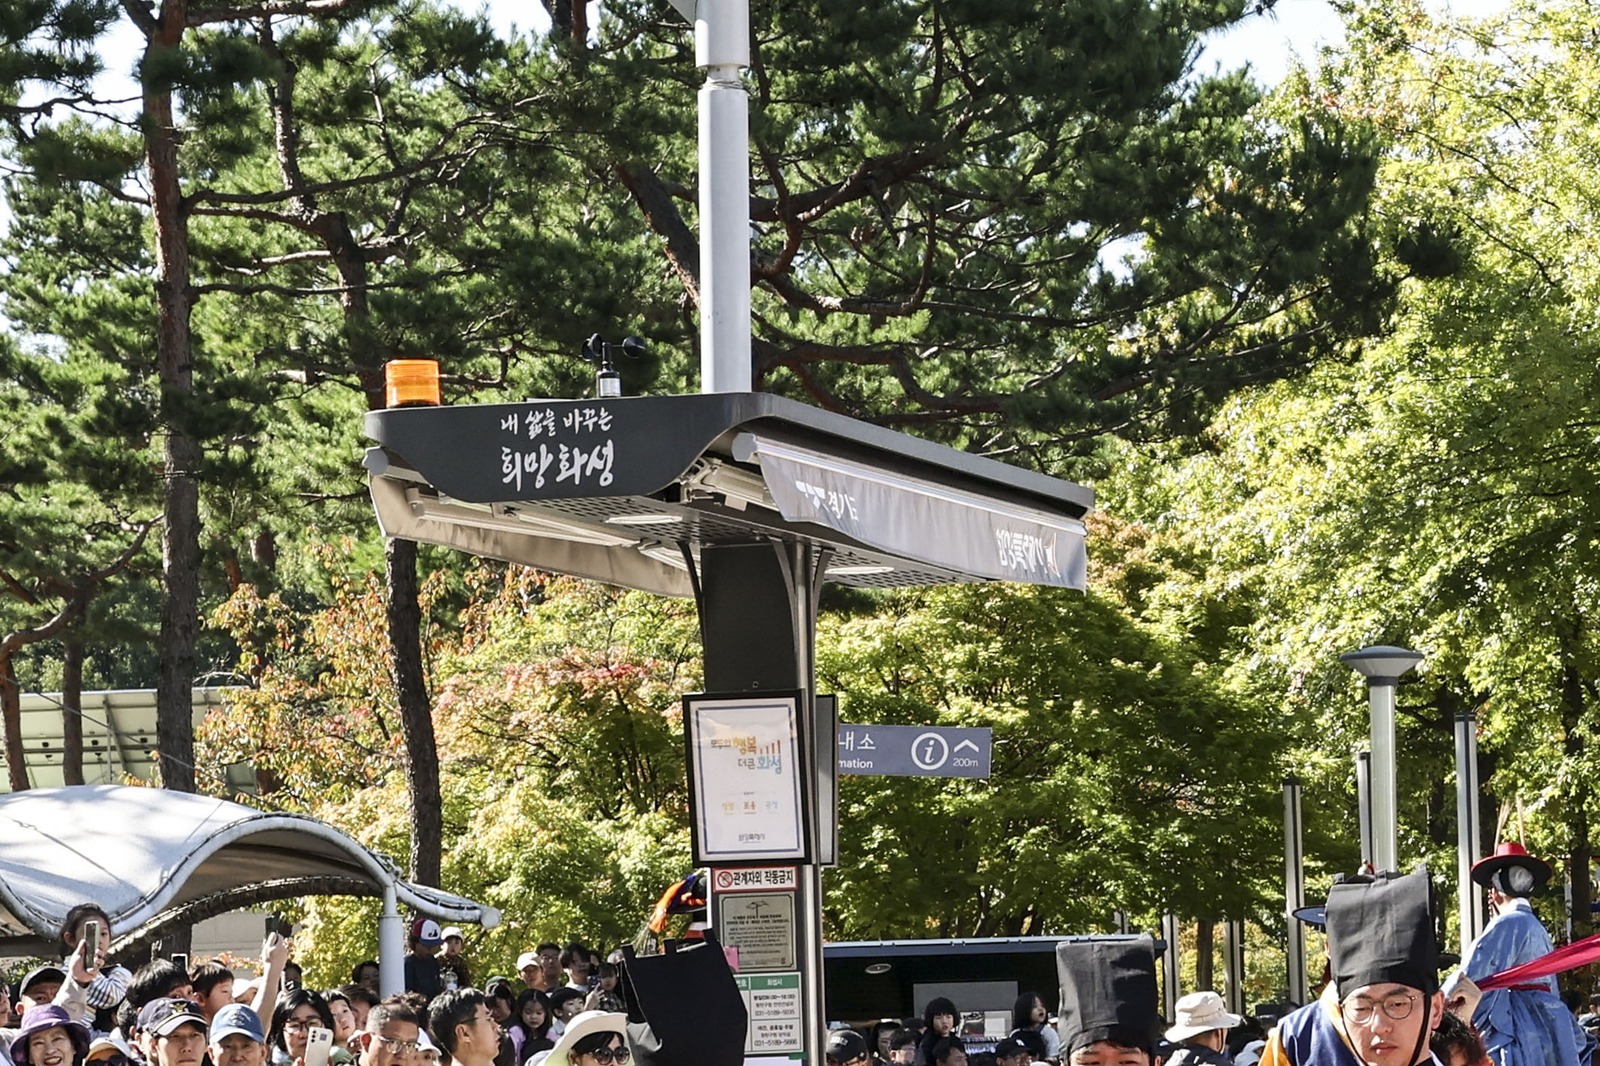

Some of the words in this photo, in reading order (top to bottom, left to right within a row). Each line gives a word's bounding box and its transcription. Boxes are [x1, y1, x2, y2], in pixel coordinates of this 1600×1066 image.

[500, 412, 518, 435] 내
[525, 408, 556, 440] 삶을
[563, 406, 613, 435] 바꾸는
[502, 443, 554, 492] 희망
[556, 439, 615, 487] 화성
[838, 731, 876, 752] 내소
[838, 758, 873, 769] mation
[953, 757, 979, 767] 200m
[733, 871, 762, 885] 관계자외
[764, 869, 793, 884] 작동금지
